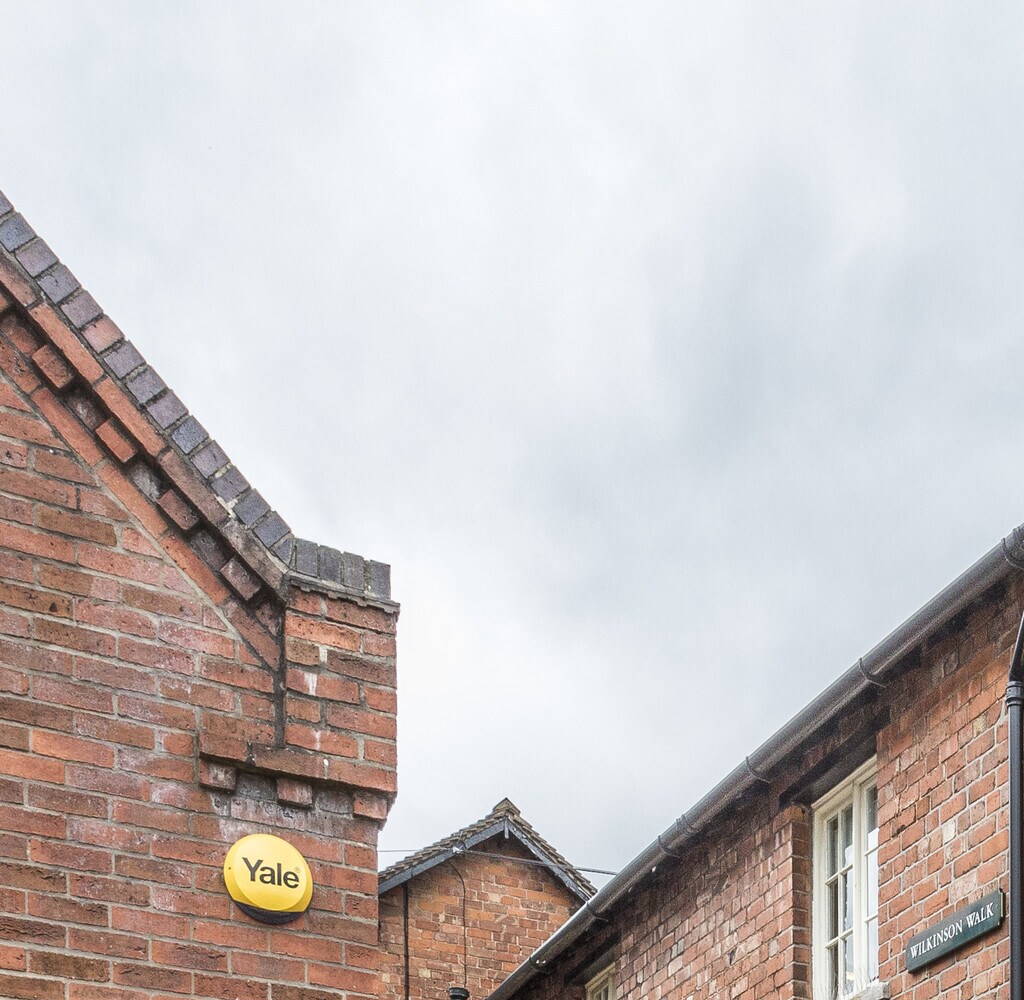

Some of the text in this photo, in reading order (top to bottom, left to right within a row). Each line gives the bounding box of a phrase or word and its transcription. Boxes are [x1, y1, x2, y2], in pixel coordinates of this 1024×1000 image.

[242, 857, 300, 889] Yale
[910, 902, 993, 959] WILKINSON WALK
